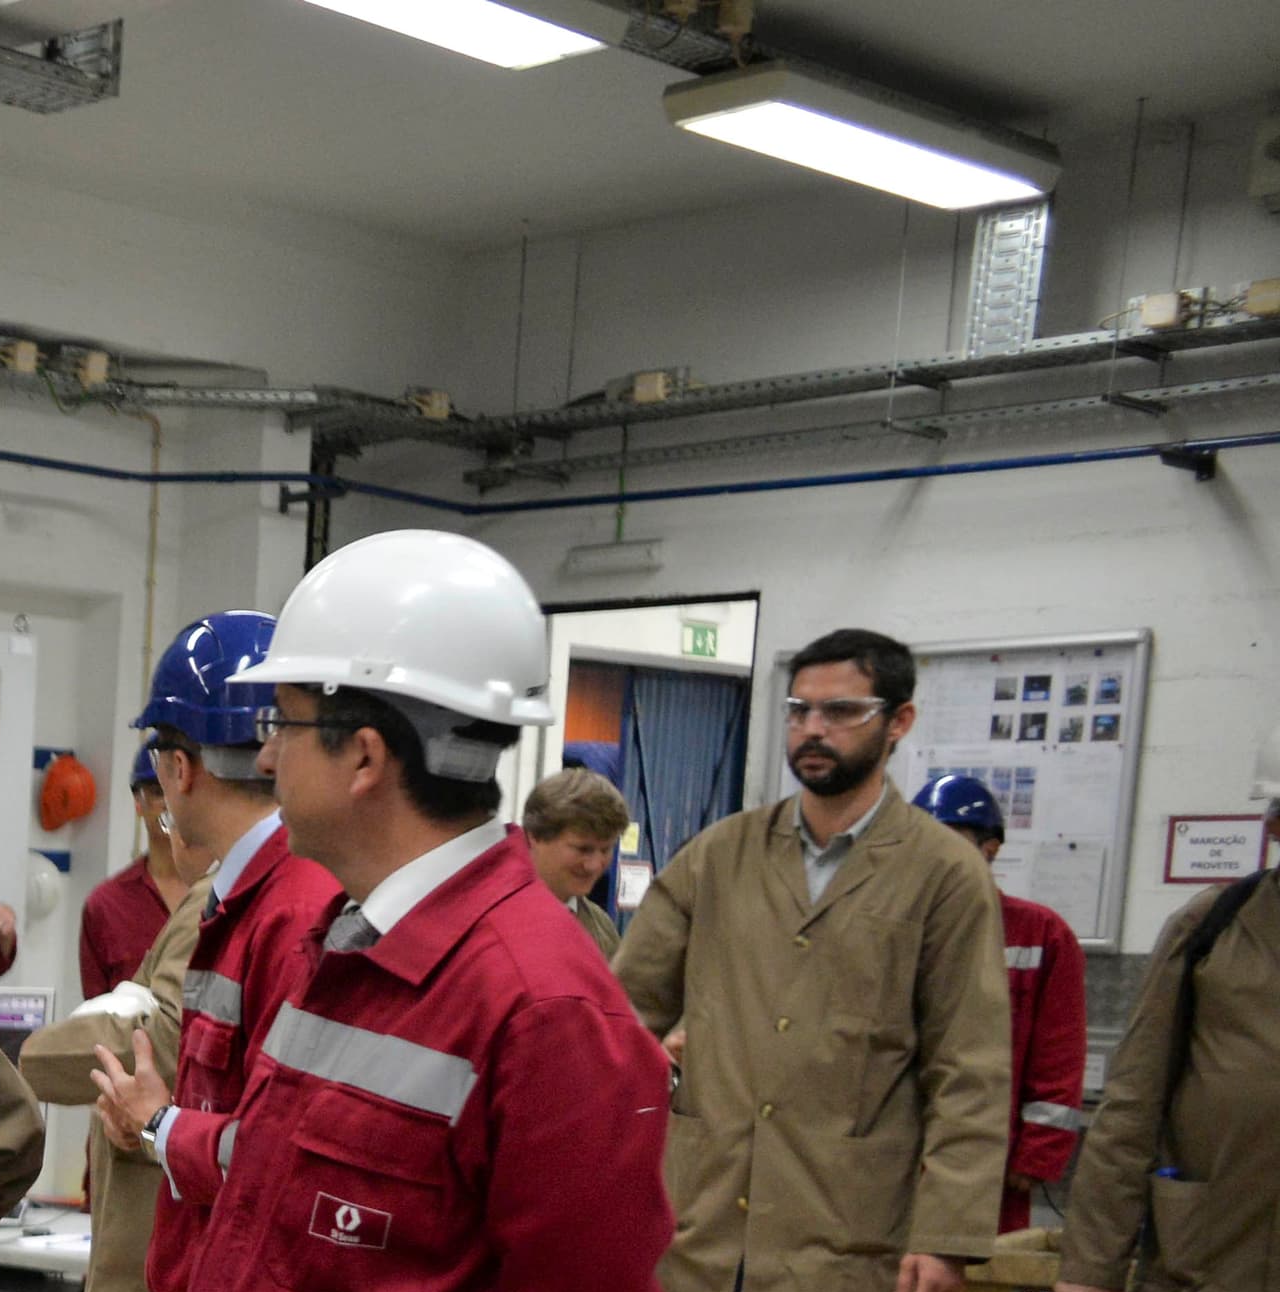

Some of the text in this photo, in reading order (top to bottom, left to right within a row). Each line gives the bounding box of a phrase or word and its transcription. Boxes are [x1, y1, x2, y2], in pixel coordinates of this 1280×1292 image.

[1189, 834, 1247, 846] MARCAÇÃO
[1209, 849, 1223, 858] DE
[1190, 861, 1240, 870] PROVETES
